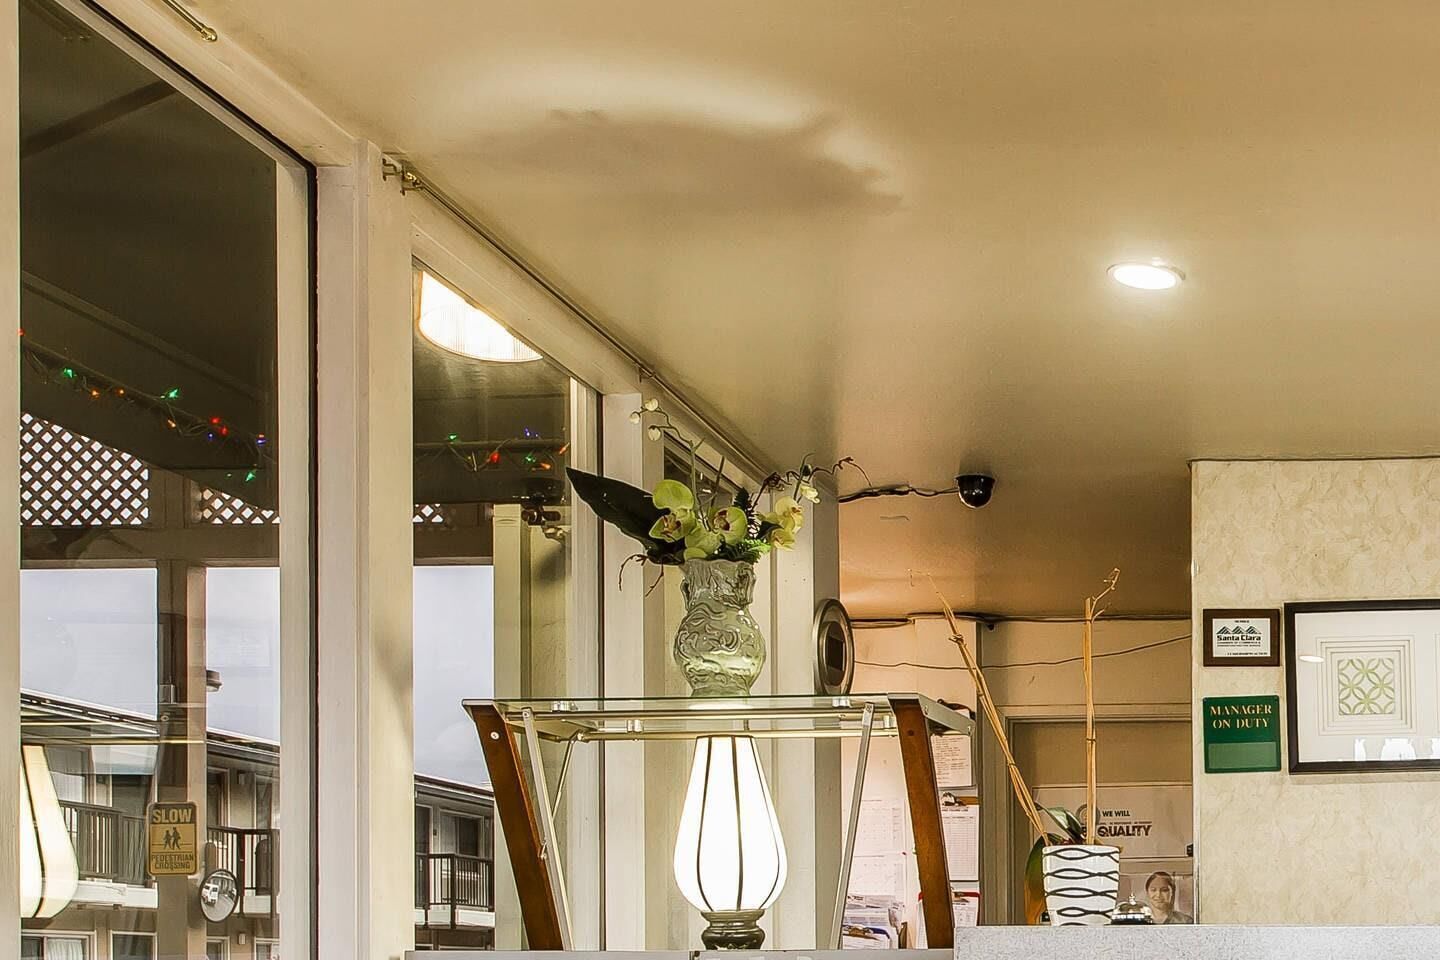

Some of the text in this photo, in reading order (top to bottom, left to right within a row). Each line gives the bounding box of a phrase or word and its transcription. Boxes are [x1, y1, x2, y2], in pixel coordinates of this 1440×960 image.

[1210, 704, 1272, 715] MANAGER
[1212, 718, 1270, 729] ON DUTY
[152, 808, 192, 823] SLOW
[1097, 825, 1153, 837] QUALITY
[151, 853, 194, 862] PEDESTRIAN
